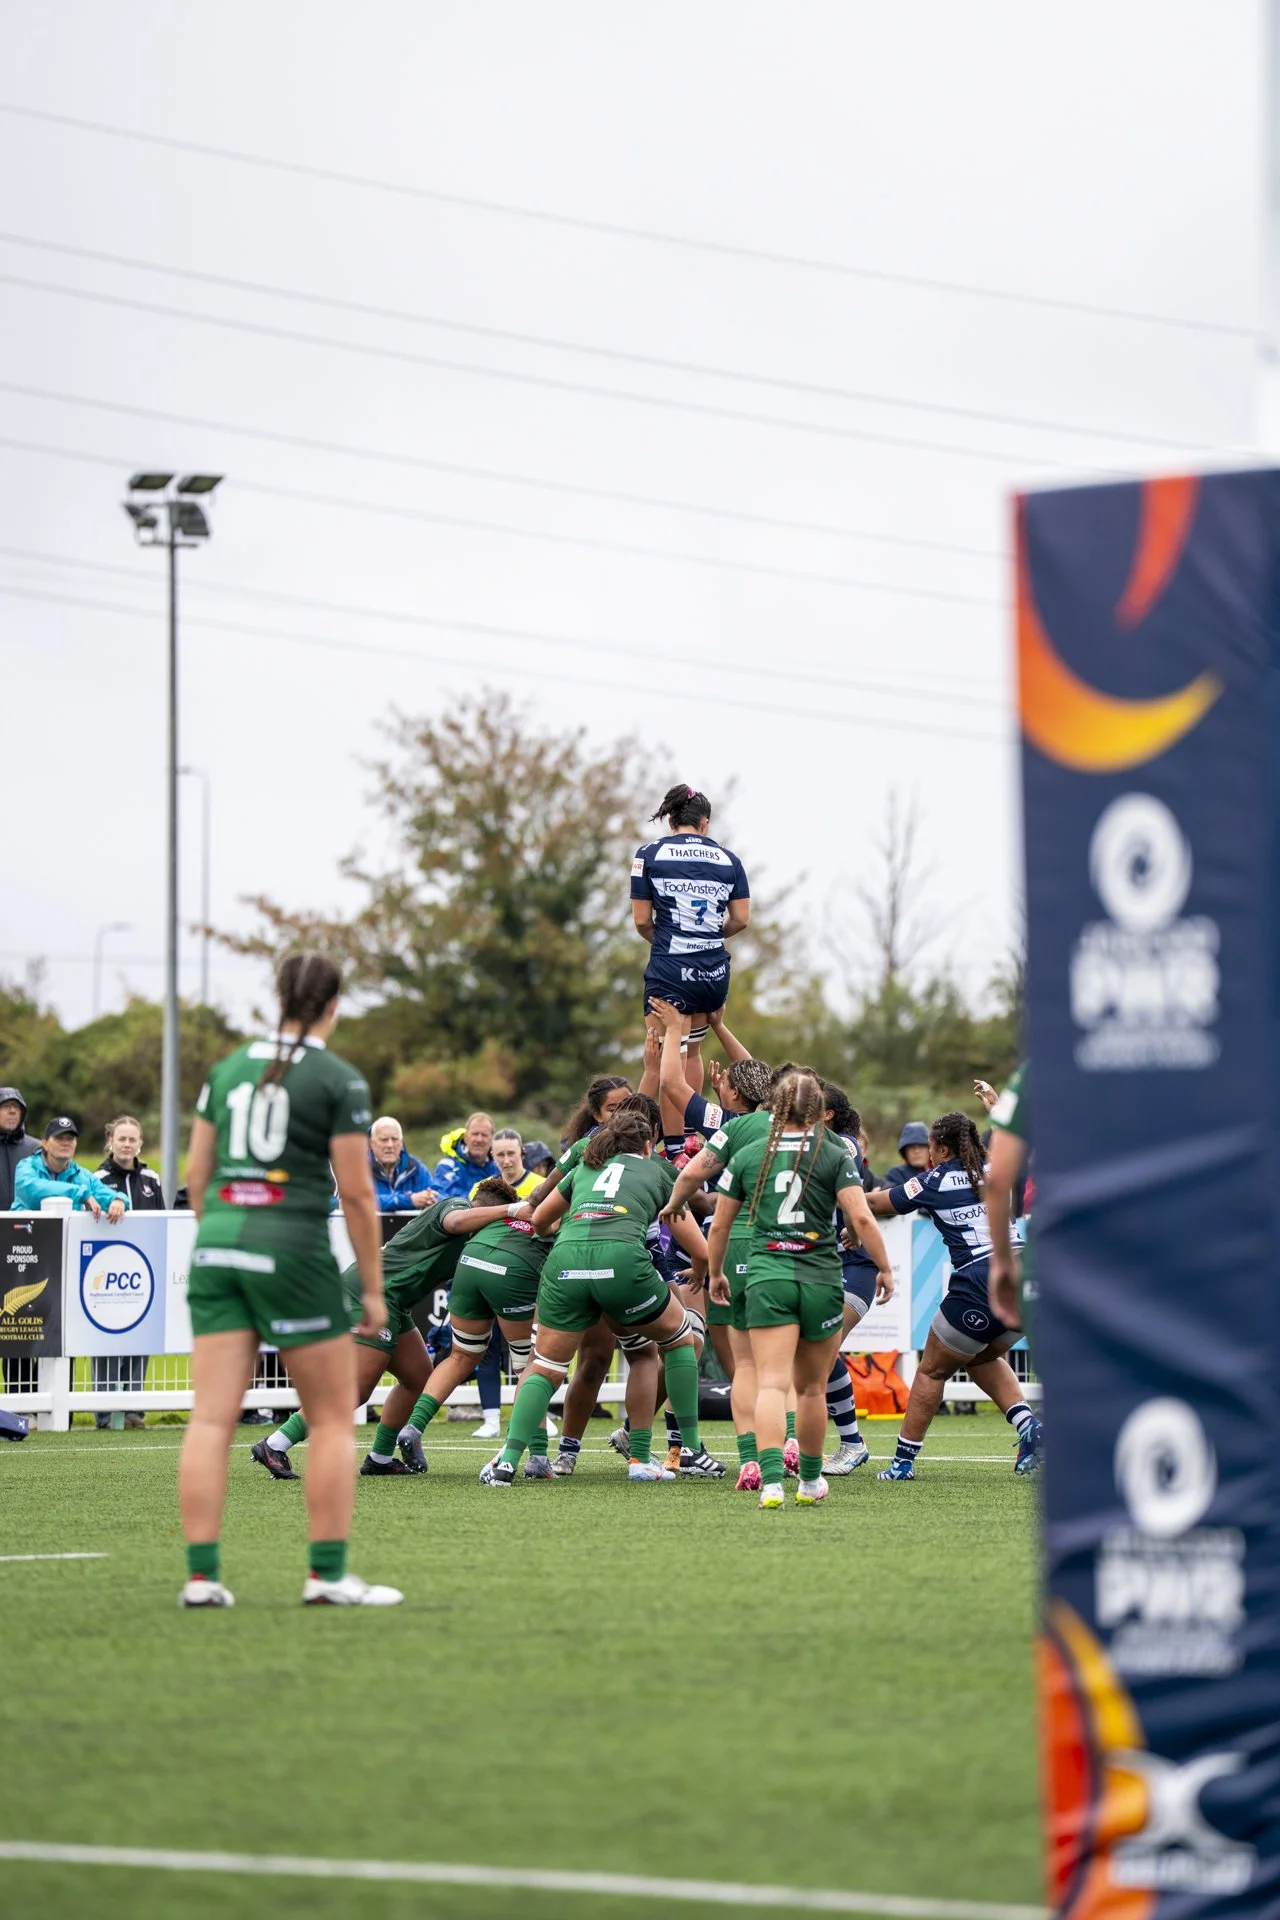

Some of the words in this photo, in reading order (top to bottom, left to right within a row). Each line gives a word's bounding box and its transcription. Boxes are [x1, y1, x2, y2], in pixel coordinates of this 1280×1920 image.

[668, 847, 720, 861] THATCHERS
[690, 899, 708, 925] 7
[226, 1082, 291, 1163] 10
[709, 1108, 719, 1127] PWR
[592, 1162, 625, 1199] 4
[774, 1169, 806, 1225] 2
[12, 1245, 33, 1254] PROUD
[6, 1254, 38, 1264] SPONSORS
[17, 1263, 27, 1273] OF
[105, 1272, 141, 1290] PCC
[2, 1317, 17, 1325] ALL
[18, 1317, 43, 1325] GOLDS
